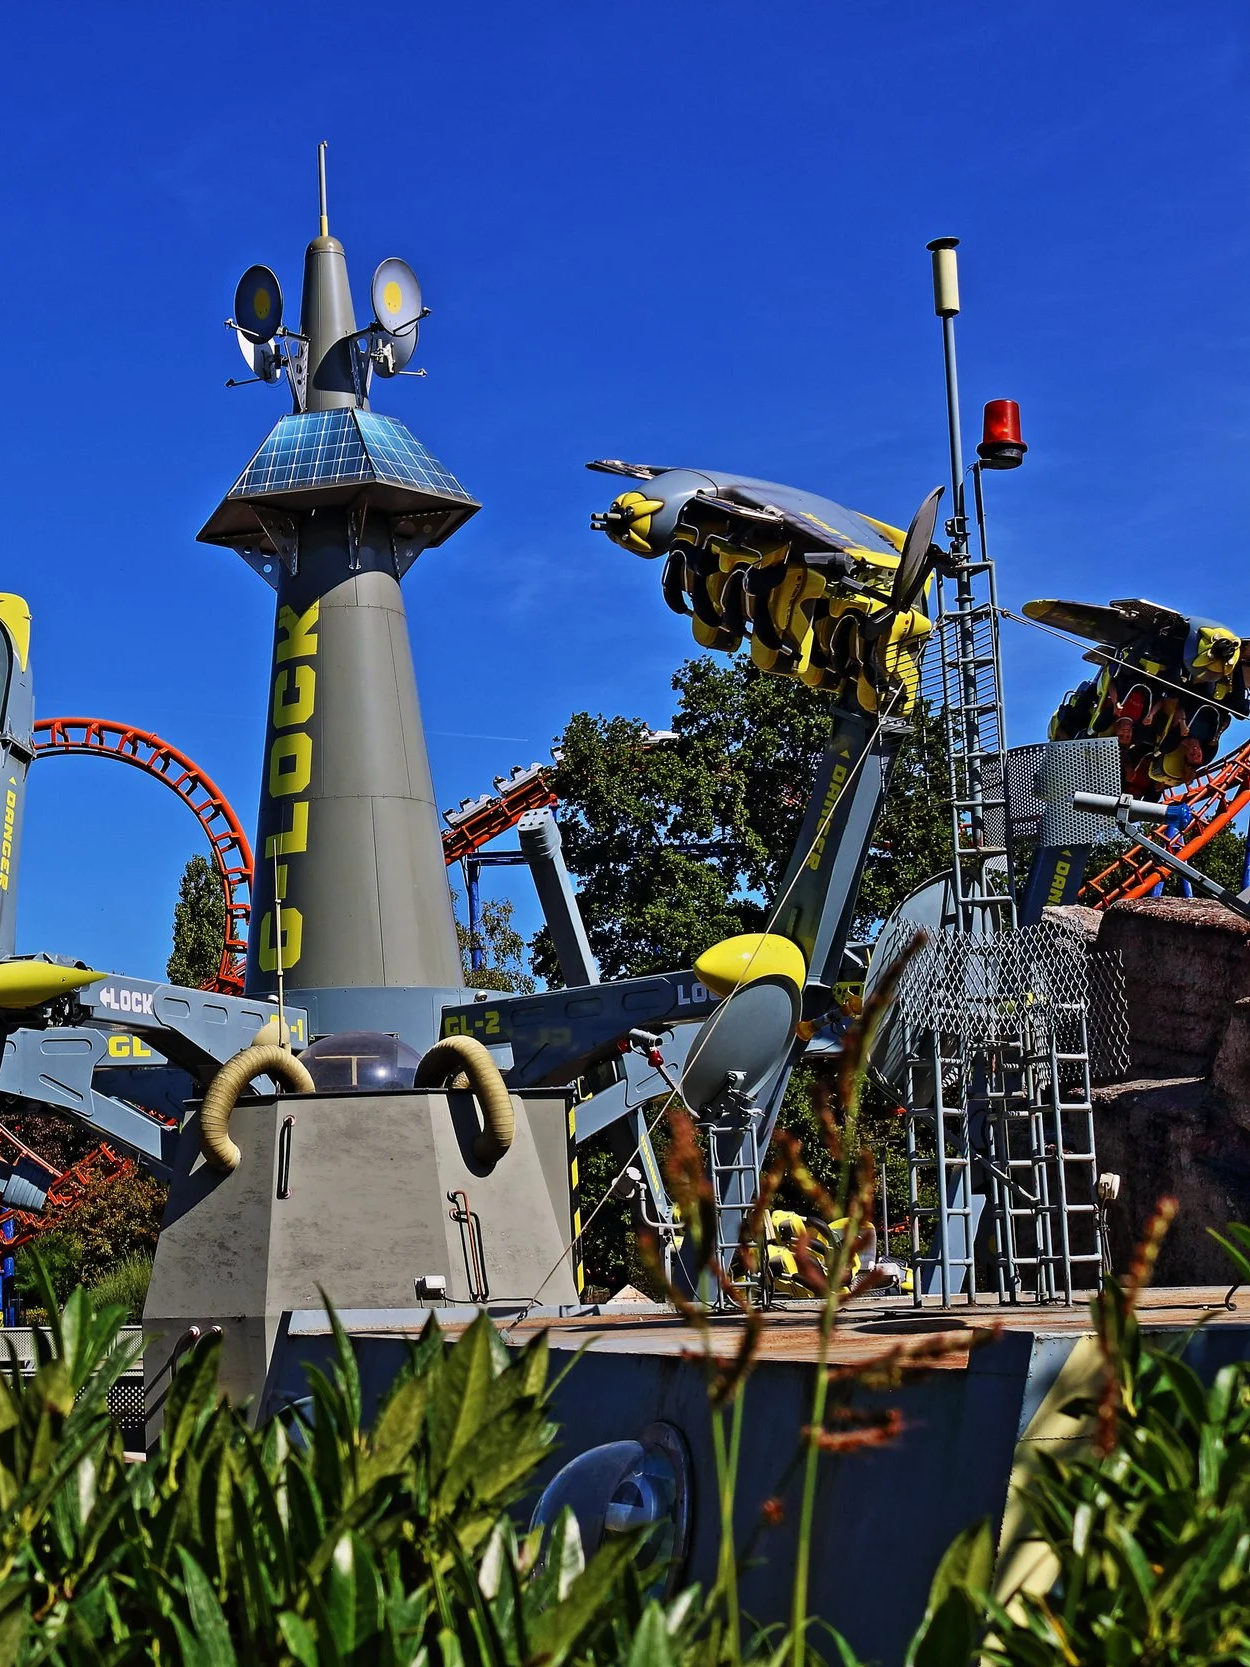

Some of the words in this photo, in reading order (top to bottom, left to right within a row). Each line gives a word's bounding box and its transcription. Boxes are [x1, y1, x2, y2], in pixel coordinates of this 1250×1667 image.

[258, 596, 320, 972] G-LOCK
[0, 789, 17, 891] DANGER
[805, 764, 847, 871] DANGER
[1046, 860, 1071, 906] DAN
[110, 989, 153, 1015] LOCK
[677, 982, 723, 1006] LO
[444, 1010, 500, 1036] GL-2
